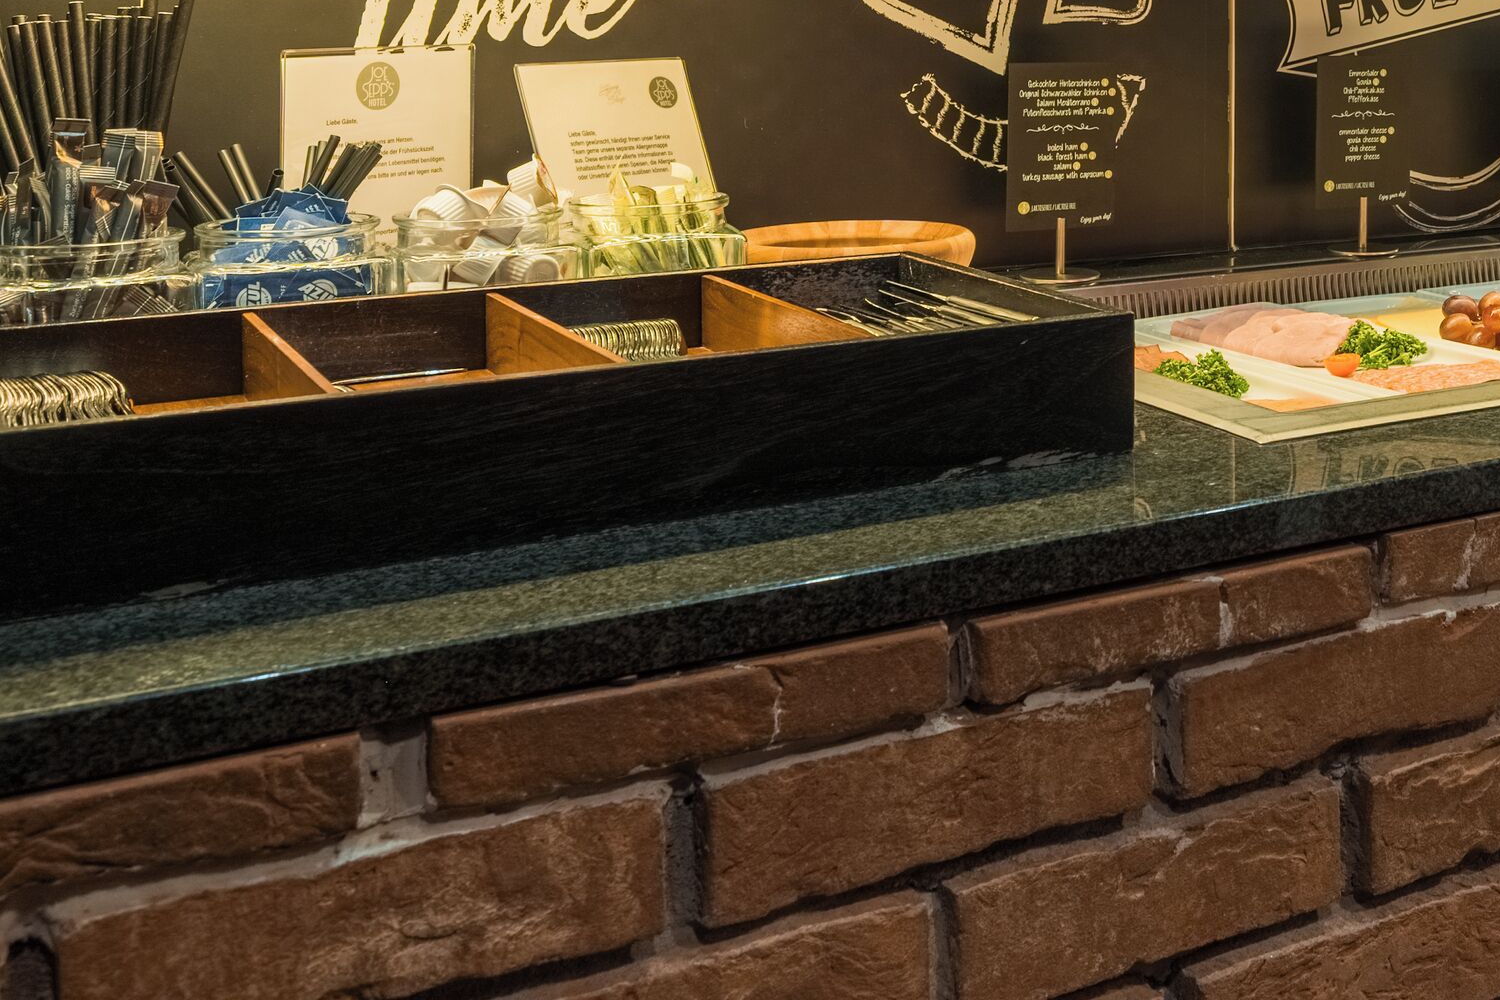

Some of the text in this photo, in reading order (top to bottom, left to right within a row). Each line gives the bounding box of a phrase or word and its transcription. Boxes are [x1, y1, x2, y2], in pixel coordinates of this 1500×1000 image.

[1348, 69, 1379, 78] Emmentaler
[1028, 78, 1101, 89] Gekochter Hinterschinken
[1356, 77, 1372, 86] Gouda
[1019, 89, 1040, 99] Original
[1083, 87, 1108, 97] Schinken
[368, 97, 388, 107] HOTEL
[1036, 97, 1091, 107] Salami Mediterrano
[1022, 106, 1107, 118] Putenfleischwurst mit Paprika
[326, 119, 341, 127] Liebe
[567, 130, 581, 138] Liebe
[1338, 126, 1388, 136] emmentaler cheese
[1346, 135, 1379, 146] gouda cheese
[1064, 142, 1079, 151] ham
[1349, 144, 1377, 152] chili cheese
[1037, 151, 1088, 162] black forest ham
[1344, 153, 1381, 163] pepper cheese
[388, 159, 420, 167] Lebensmittel
[1053, 162, 1072, 171] salami
[378, 171, 390, 179] bitte
[416, 168, 430, 176] legen
[1022, 171, 1105, 183] turkey sausage with capsicum
